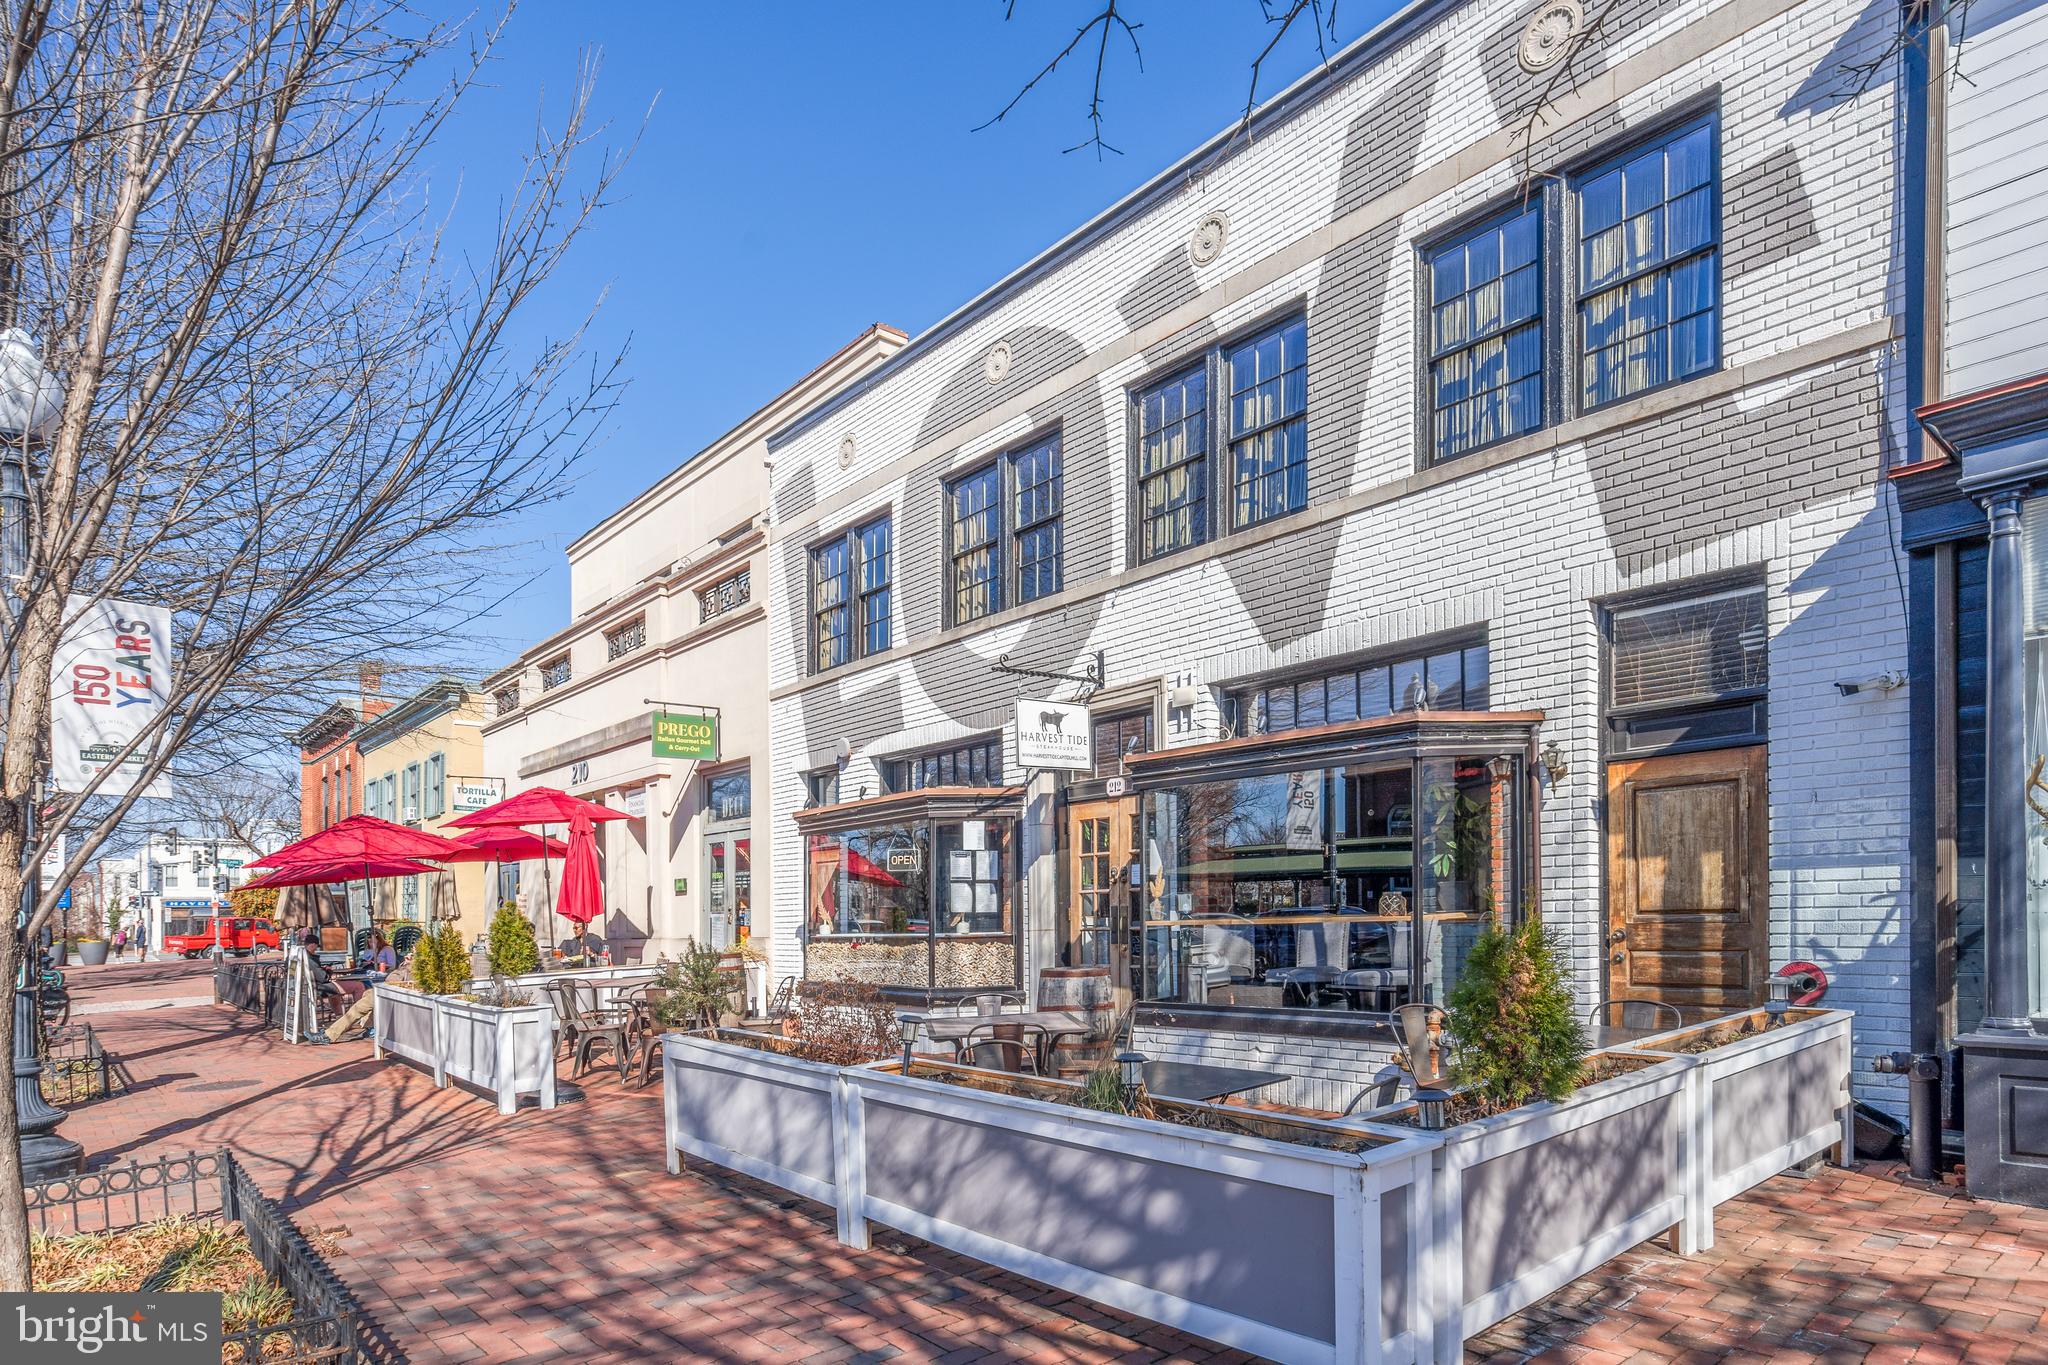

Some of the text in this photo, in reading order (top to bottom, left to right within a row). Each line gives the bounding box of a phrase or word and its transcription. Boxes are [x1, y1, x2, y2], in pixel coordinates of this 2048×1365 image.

[115, 618, 152, 708] YEARS
[73, 664, 111, 706] 150
[658, 721, 711, 738] PREGO
[657, 735, 675, 743] Italian
[676, 737, 700, 745] Gourmet
[1021, 731, 1088, 746] HARVEST TIDE
[674, 744, 700, 753] Carry-Out
[82, 752, 114, 761] EASTERN
[571, 760, 589, 786] 210
[457, 786, 497, 797] TORTILLA
[1109, 780, 1121, 793] 212
[467, 796, 487, 805] CAFE
[722, 795, 743, 818] DELI
[891, 855, 918, 866] OPEN
